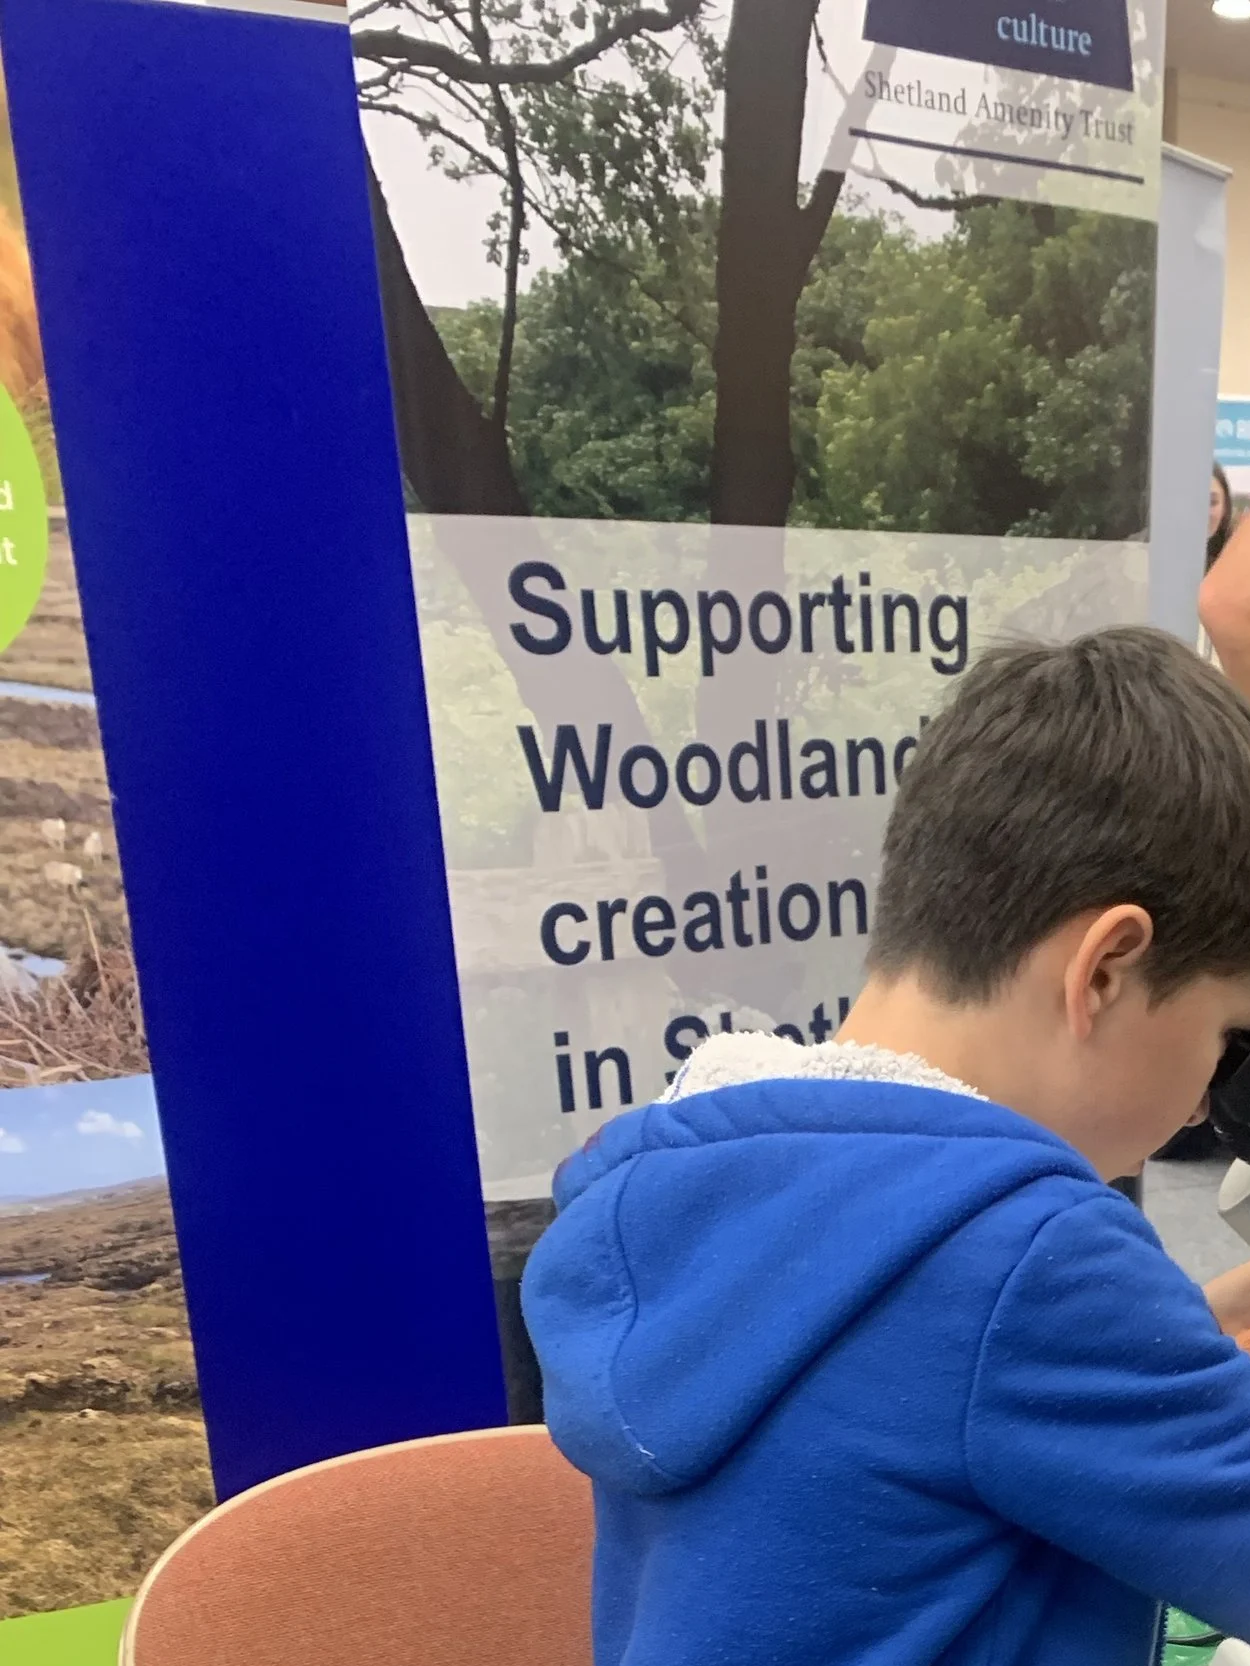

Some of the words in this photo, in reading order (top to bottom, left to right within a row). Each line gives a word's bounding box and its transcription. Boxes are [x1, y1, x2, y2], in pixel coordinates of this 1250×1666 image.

[996, 13, 1092, 56] culture
[863, 70, 967, 116] Shetland
[974, 92, 1075, 141] Amenity
[1080, 109, 1134, 146] Trust
[508, 560, 969, 677] Supporting
[540, 864, 869, 966] creation
[553, 1030, 634, 1114] in
